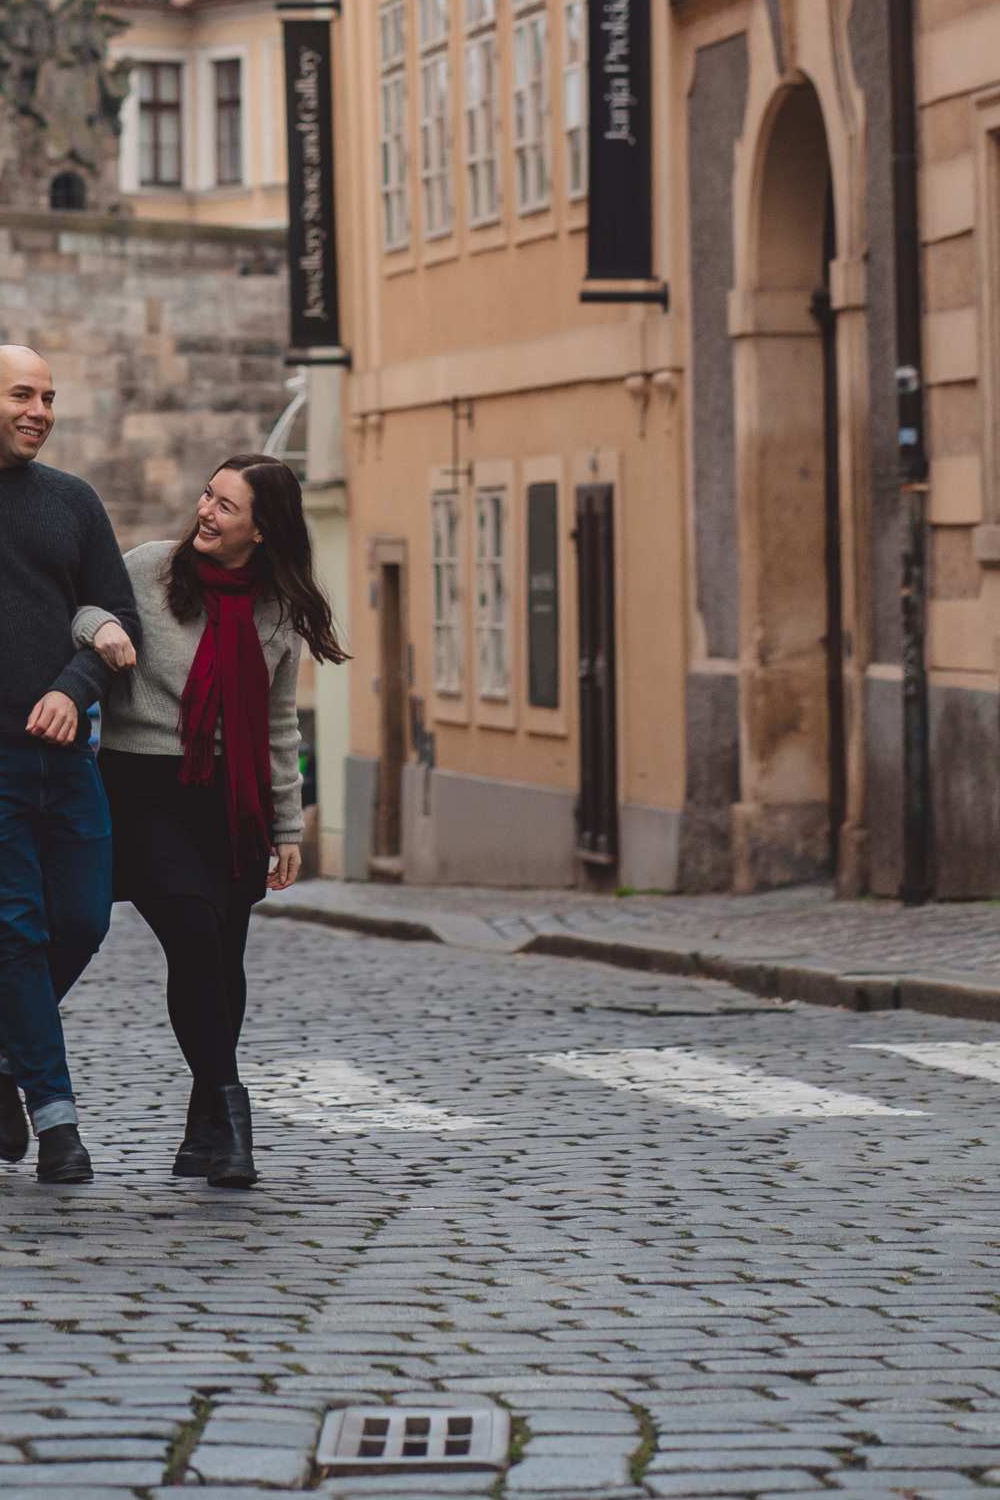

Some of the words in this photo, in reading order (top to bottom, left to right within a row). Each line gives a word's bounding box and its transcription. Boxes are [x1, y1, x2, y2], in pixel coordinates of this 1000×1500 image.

[294, 45, 322, 122] Gallery
[603, 77, 638, 146] Janja
[294, 123, 321, 165] and
